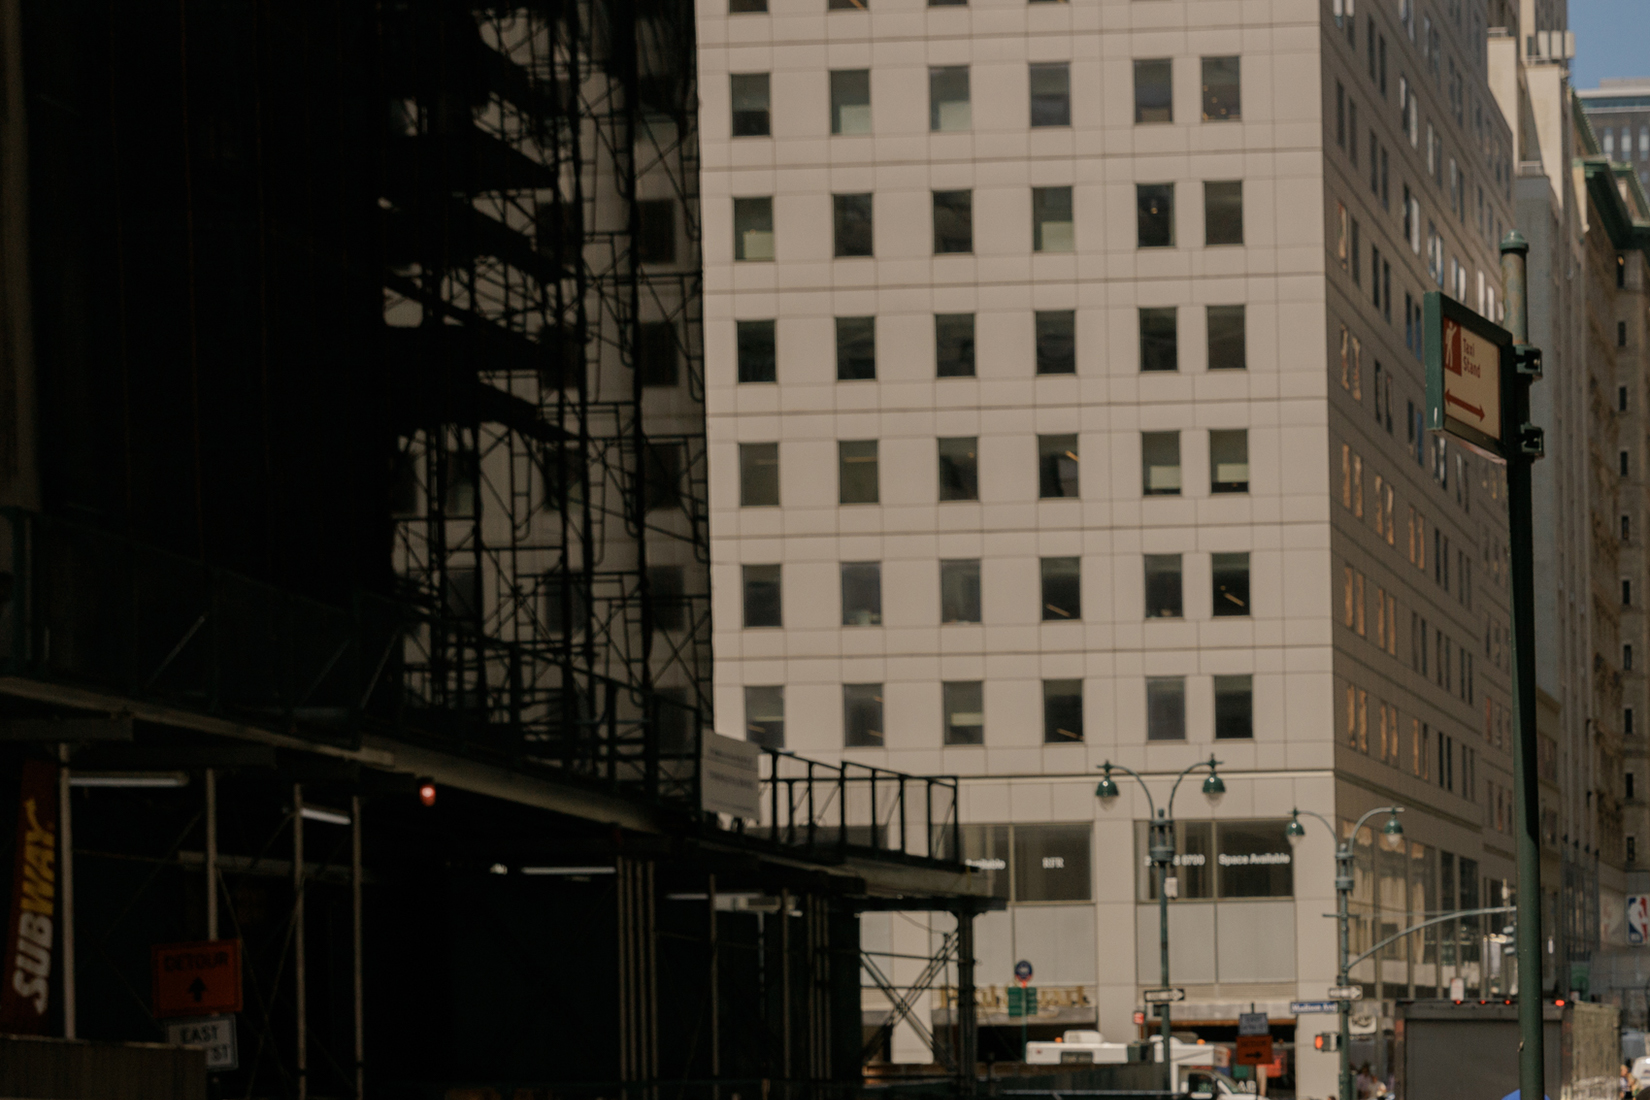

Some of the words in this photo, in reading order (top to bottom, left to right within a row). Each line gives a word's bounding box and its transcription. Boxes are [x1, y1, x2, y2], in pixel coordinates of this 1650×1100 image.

[1463, 338, 1475, 357] Taxi
[1463, 355, 1481, 379] Stand
[1250, 853, 1291, 865] Available
[12, 796, 56, 1015] SUBWAY
[182, 1025, 218, 1043] EAST
